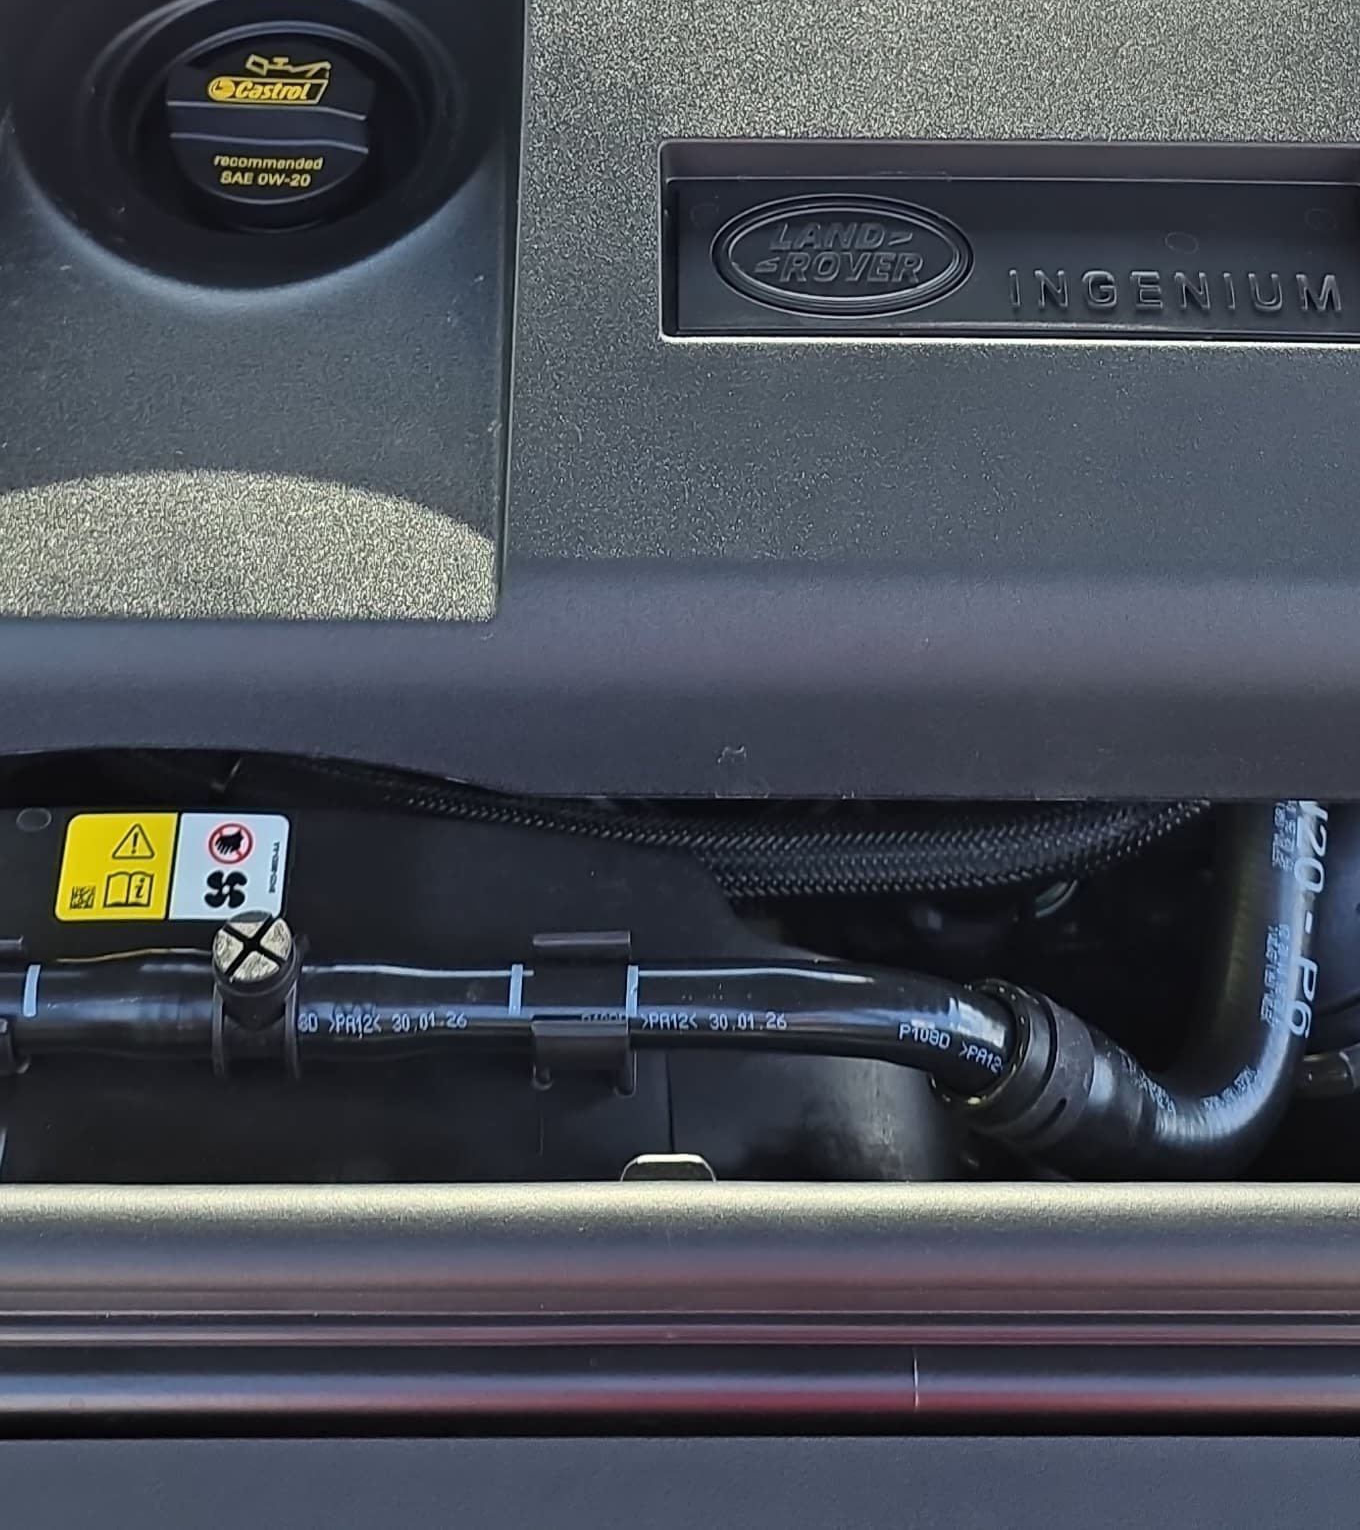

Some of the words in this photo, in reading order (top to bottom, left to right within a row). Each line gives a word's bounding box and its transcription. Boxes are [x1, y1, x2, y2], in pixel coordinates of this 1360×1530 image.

[234, 81, 310, 101] Castrol
[213, 154, 324, 170] recommended
[220, 170, 253, 185] SAE
[257, 172, 311, 188] 0W-20
[769, 221, 886, 250] LAND
[778, 251, 924, 283] ROVER
[1008, 268, 1342, 312] INGENIUM
